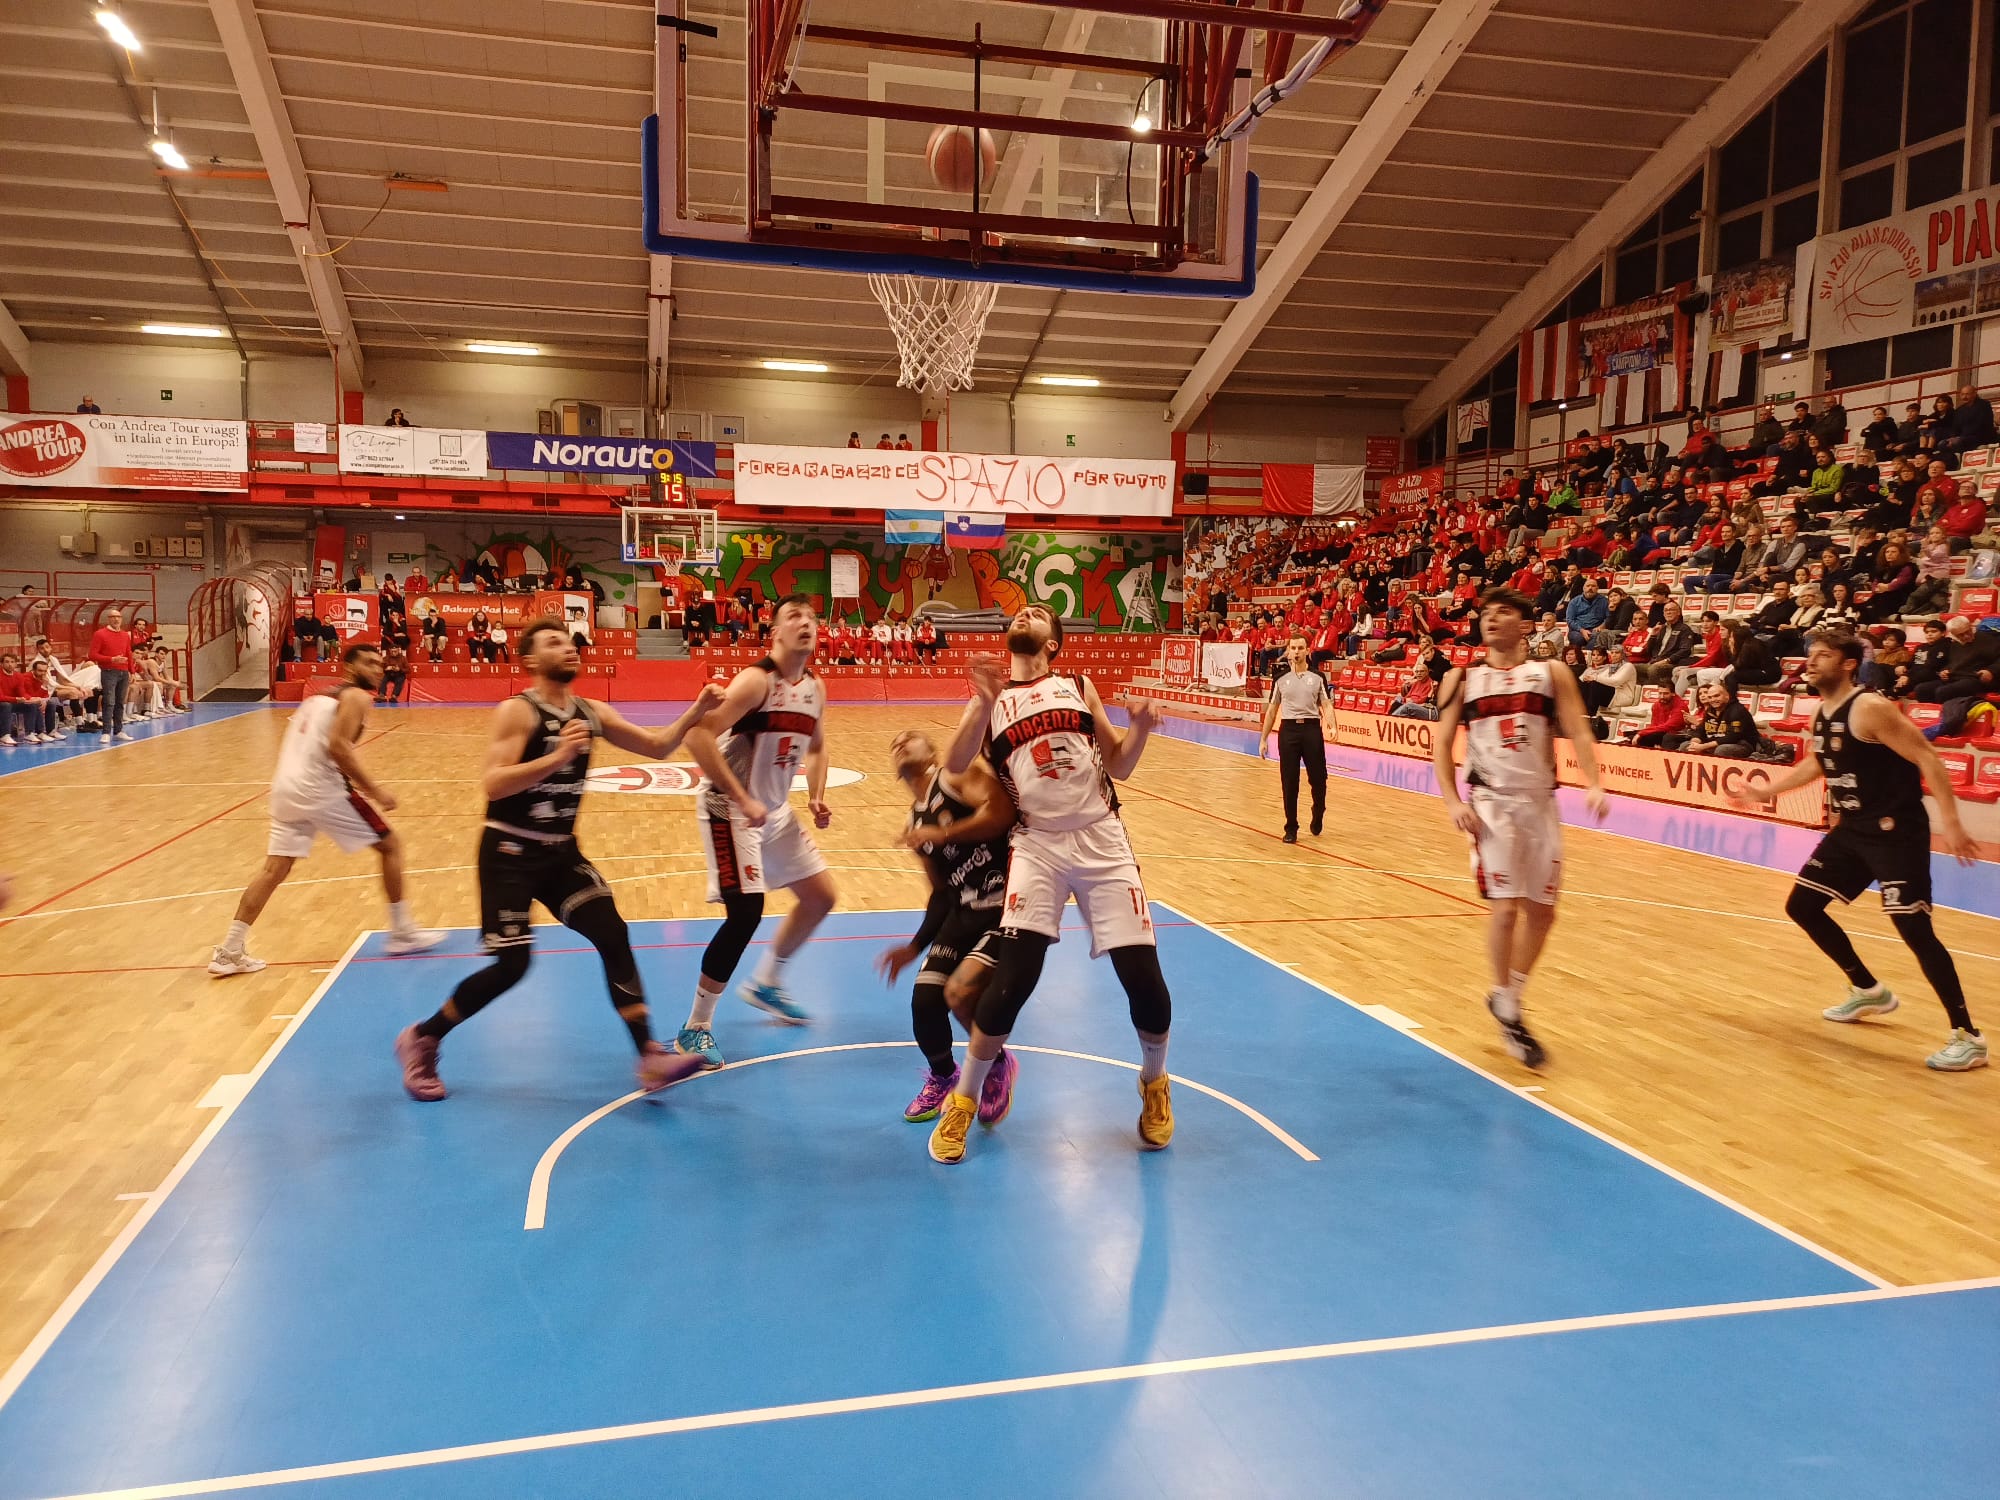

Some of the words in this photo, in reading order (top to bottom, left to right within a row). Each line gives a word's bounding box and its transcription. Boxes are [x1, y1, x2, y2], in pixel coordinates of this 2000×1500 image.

[1928, 198, 2000, 273] PIA
[1819, 246, 1850, 300] SPAZIO
[1851, 226, 1922, 279] BIANCOROSSO
[0, 422, 67, 451] ANDREA
[88, 418, 116, 430] Con
[120, 420, 166, 432] Andrea
[170, 421, 199, 434] Tour
[203, 424, 239, 438] viaggi
[33, 436, 83, 462] TOUR
[114, 433, 127, 443] in
[131, 432, 162, 444] Italia
[165, 436, 172, 444] e
[175, 434, 187, 445] in
[192, 435, 239, 450] Europa!
[532, 439, 674, 470] Norauto
[660, 472, 683, 484] 9:15
[738, 459, 801, 477] FORZA
[804, 462, 892, 480] RAGAZZI
[915, 455, 1066, 511] SPAZIO
[1073, 469, 1108, 486] PER
[1113, 472, 1166, 490] TUTTI
[664, 484, 683, 502] 15
[442, 604, 480, 615] Bakery
[481, 605, 520, 615] Basket
[604, 631, 614, 639] 17
[604, 648, 614, 656] 17
[311, 665, 317, 673] 2
[330, 665, 337, 673] 3
[412, 665, 418, 674] 7
[452, 665, 458, 674] 9
[470, 665, 480, 674] 10
[490, 665, 499, 674] 11
[510, 665, 520, 674] 12
[605, 666, 614, 674] 17
[836, 666, 846, 675] 27
[870, 666, 881, 675] 29
[936, 666, 947, 675] 33
[1113, 667, 1122, 675] 44
[1005, 710, 1081, 747] PIACENZA
[1376, 719, 1431, 750] VINCO
[1608, 764, 1654, 781] VINCERE.
[1663, 758, 1774, 799] VINCO
[1127, 887, 1145, 915] 17
